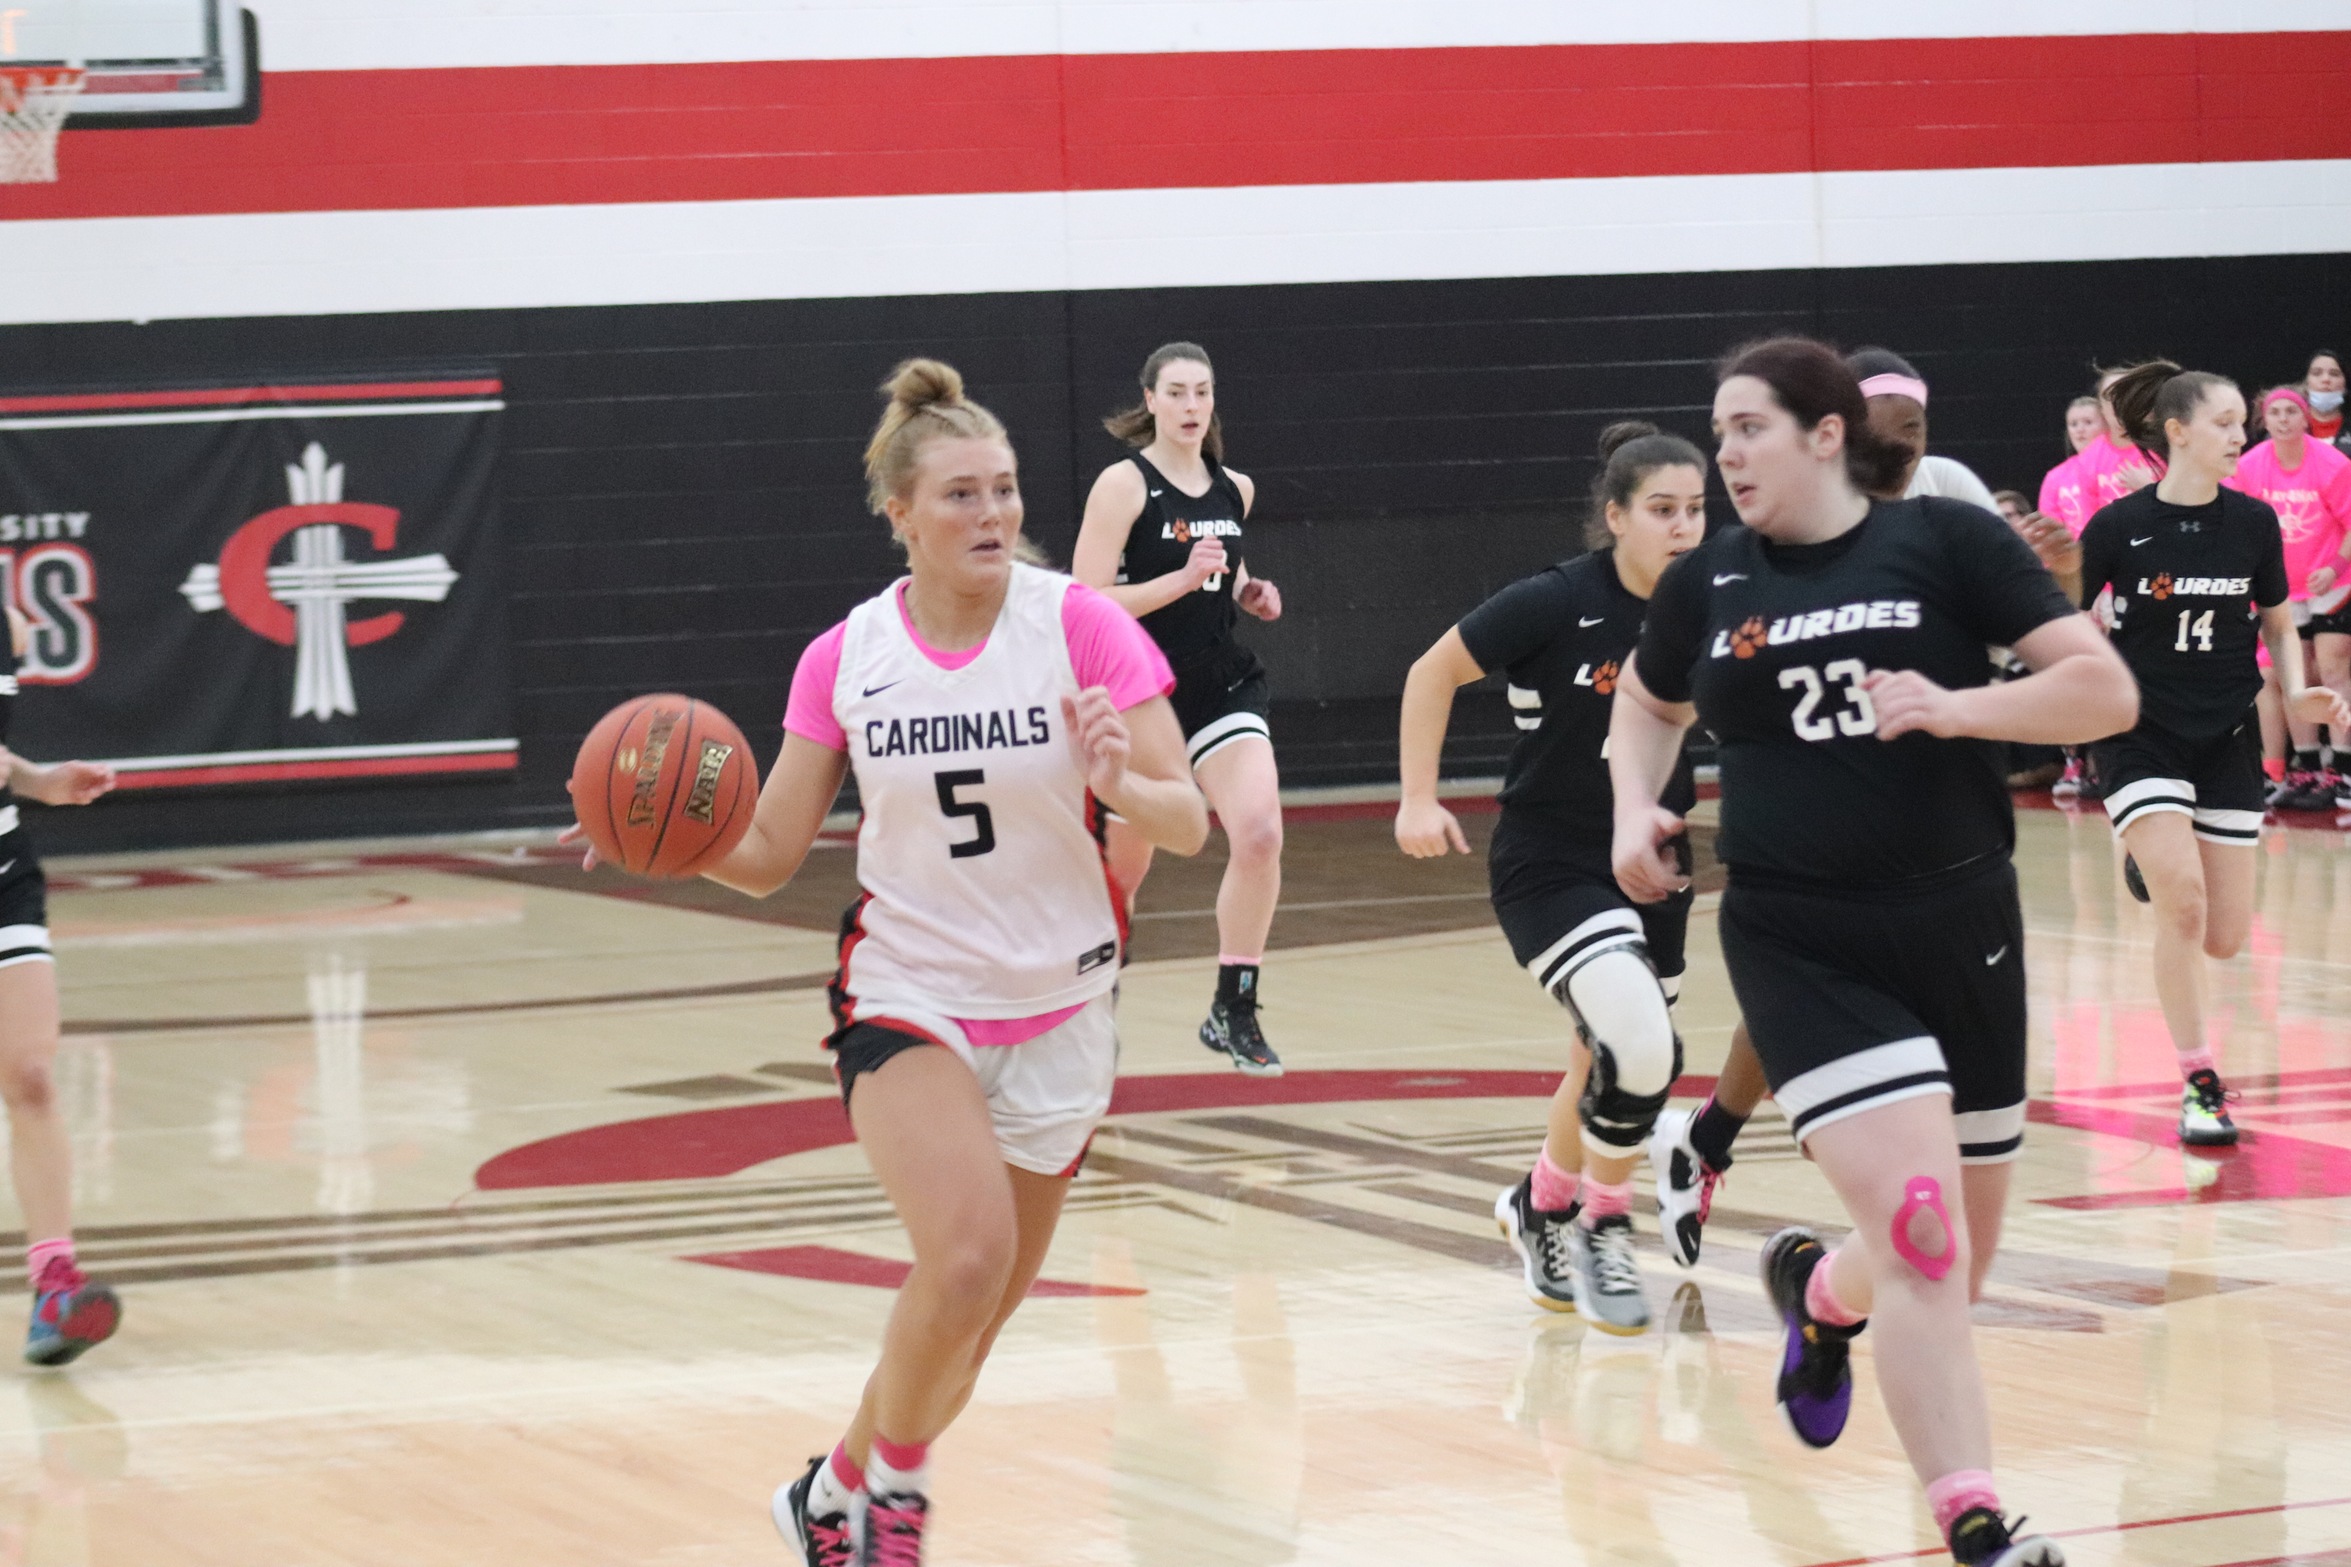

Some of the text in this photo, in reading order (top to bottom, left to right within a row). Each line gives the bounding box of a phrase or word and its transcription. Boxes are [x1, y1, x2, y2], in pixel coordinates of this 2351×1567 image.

[0, 541, 98, 685] S
[2174, 609, 2216, 652] 14
[866, 706, 1050, 757] CARDINALS
[1777, 657, 1878, 742] 23
[934, 768, 997, 859] 5
